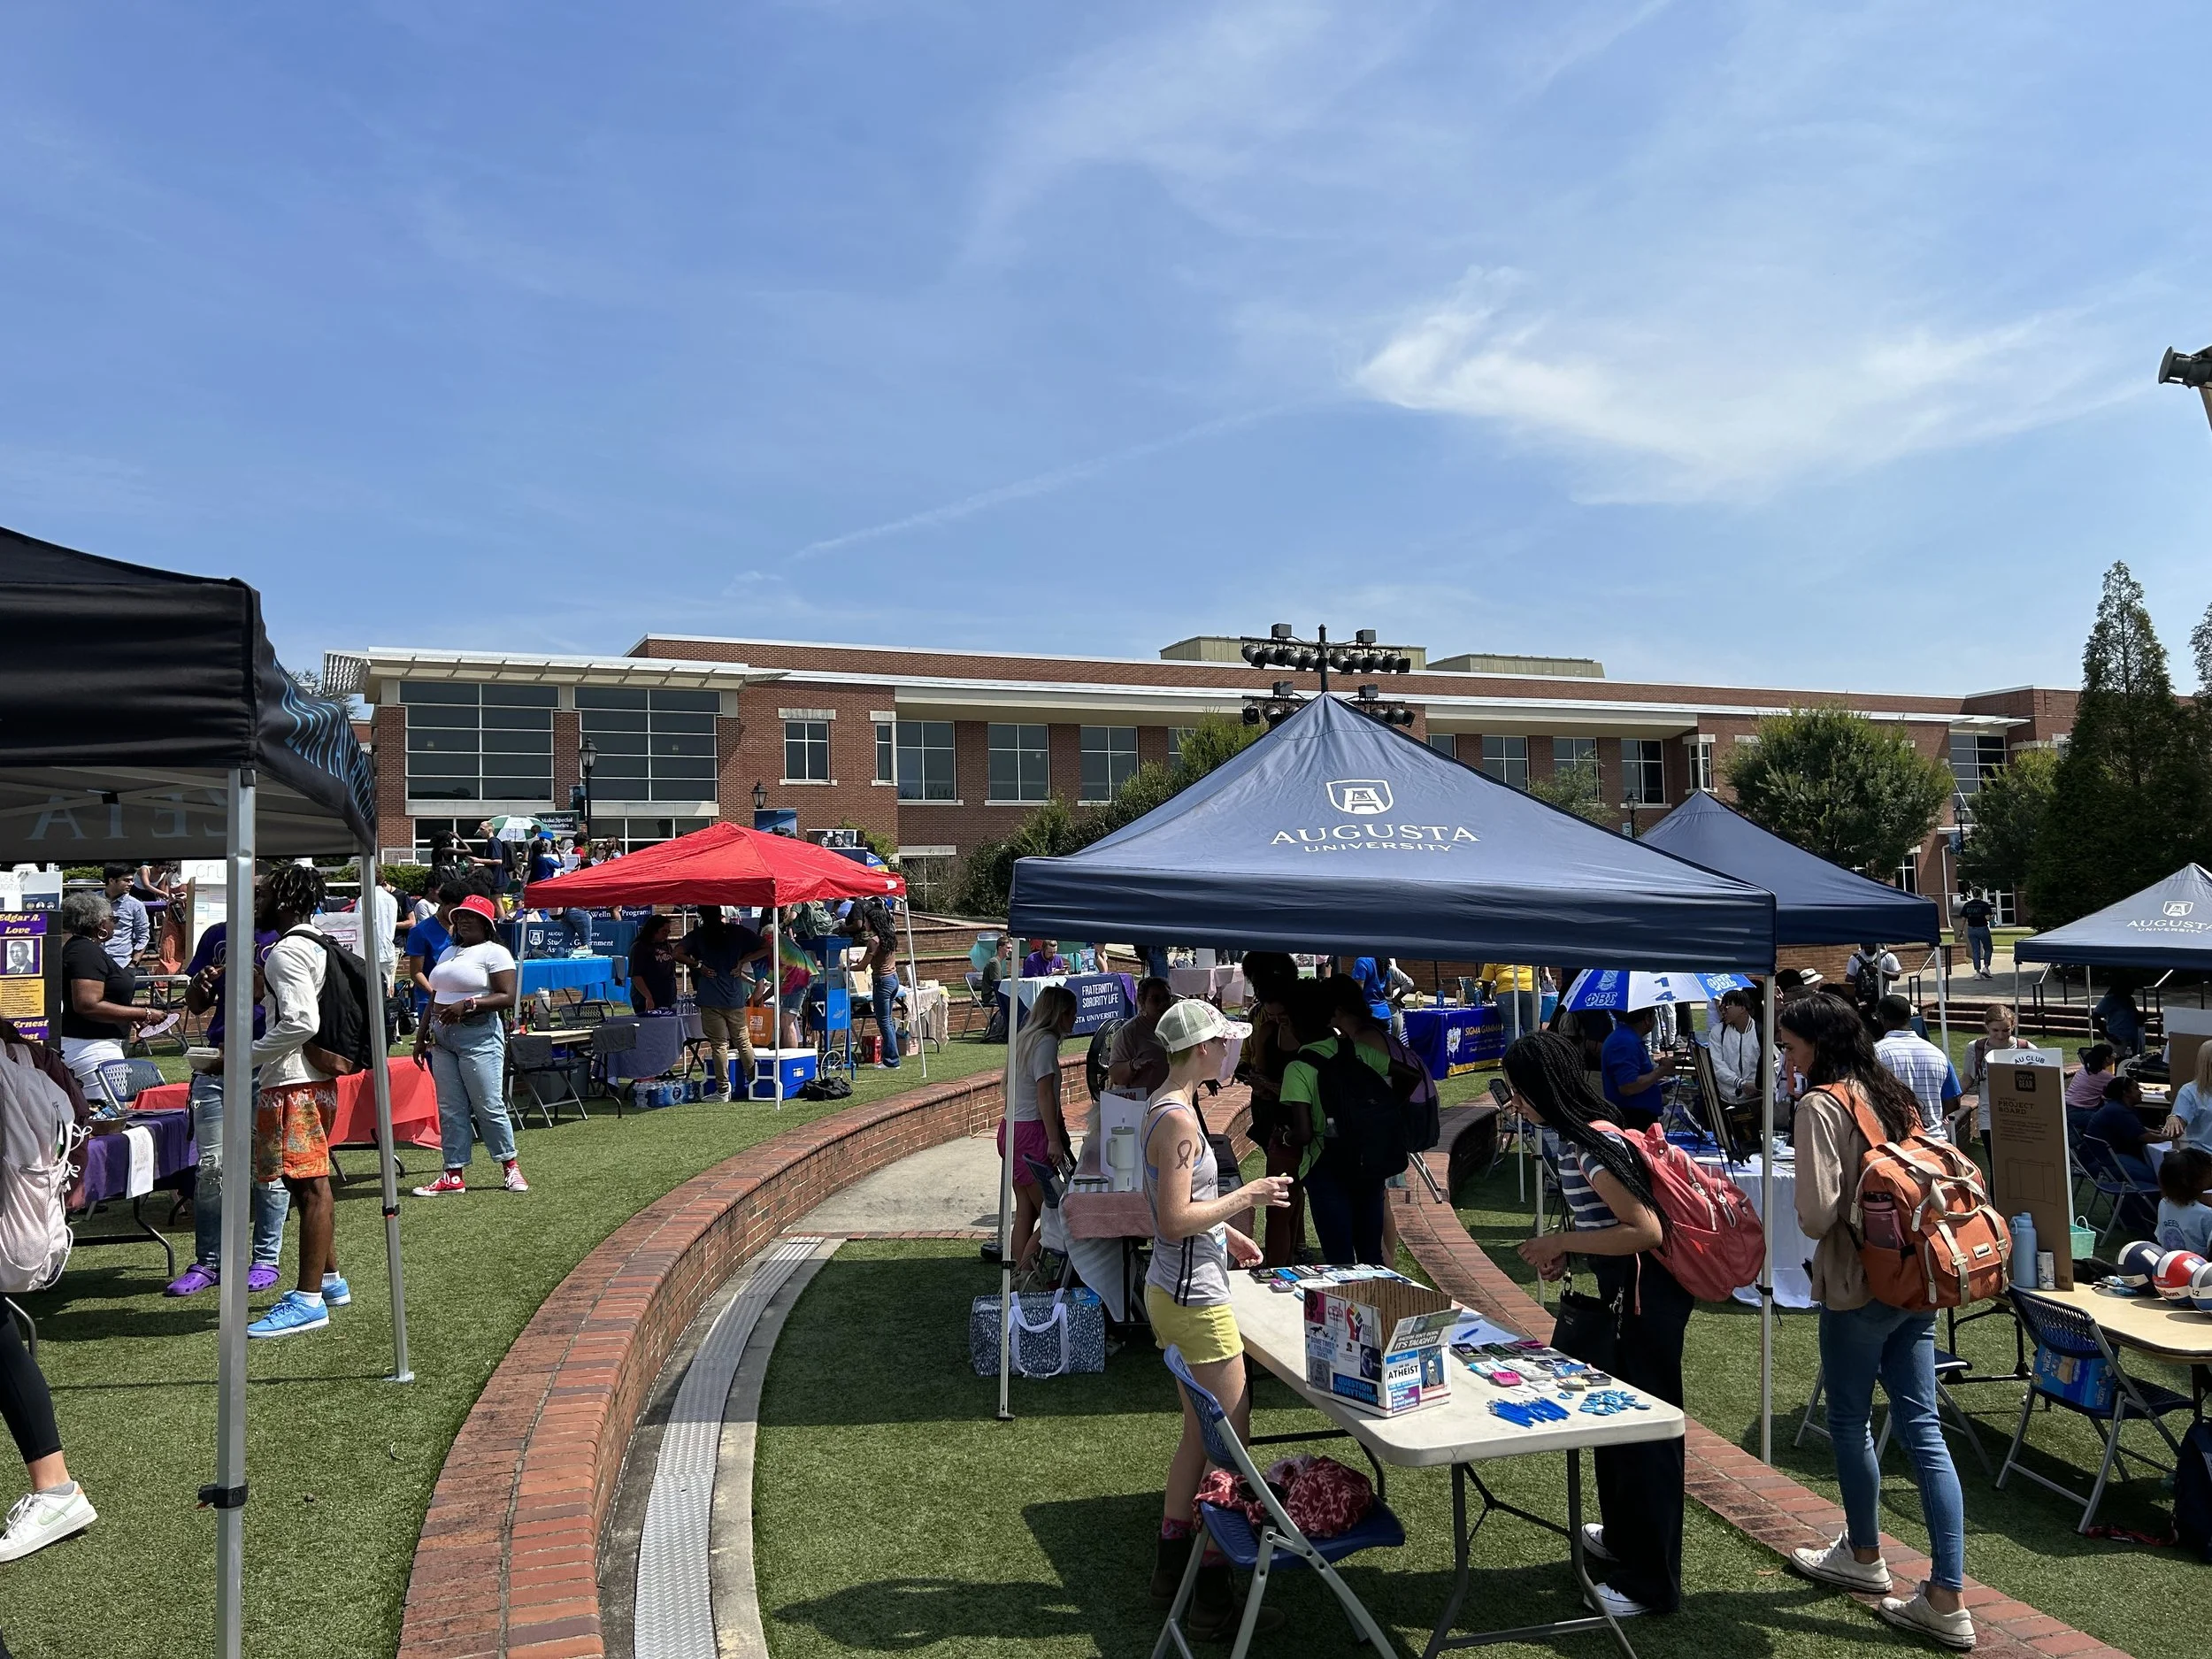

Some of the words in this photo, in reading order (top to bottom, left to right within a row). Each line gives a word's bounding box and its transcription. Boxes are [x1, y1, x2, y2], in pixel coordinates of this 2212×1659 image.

[1270, 824, 1481, 845] AUGUSTA
[1304, 841, 1452, 853] UNIVERSITY
[0, 913, 29, 923] Edgar
[1082, 982, 1114, 996] FRATERNITY
[1082, 995, 1108, 1008] SORORITY
[1108, 993, 1118, 1004] LIFE
[1585, 991, 1617, 1007] ΦΒΣ
[1087, 1010, 1119, 1022] UNIVERSITY
[13, 1019, 50, 1028] Ernest
[1465, 1026, 1480, 1036] SIGMA
[1998, 1100, 2034, 1110] PROJECT
[1311, 1336, 1335, 1348] SOMETIMES
[1394, 1340, 1408, 1350] IT'S
[1409, 1335, 1437, 1347] TAUGHT!
[1388, 1365, 1418, 1379] ATHEIST
[1337, 1375, 1373, 1394] QUESTION
[1334, 1384, 1378, 1402] EVERYTHING
